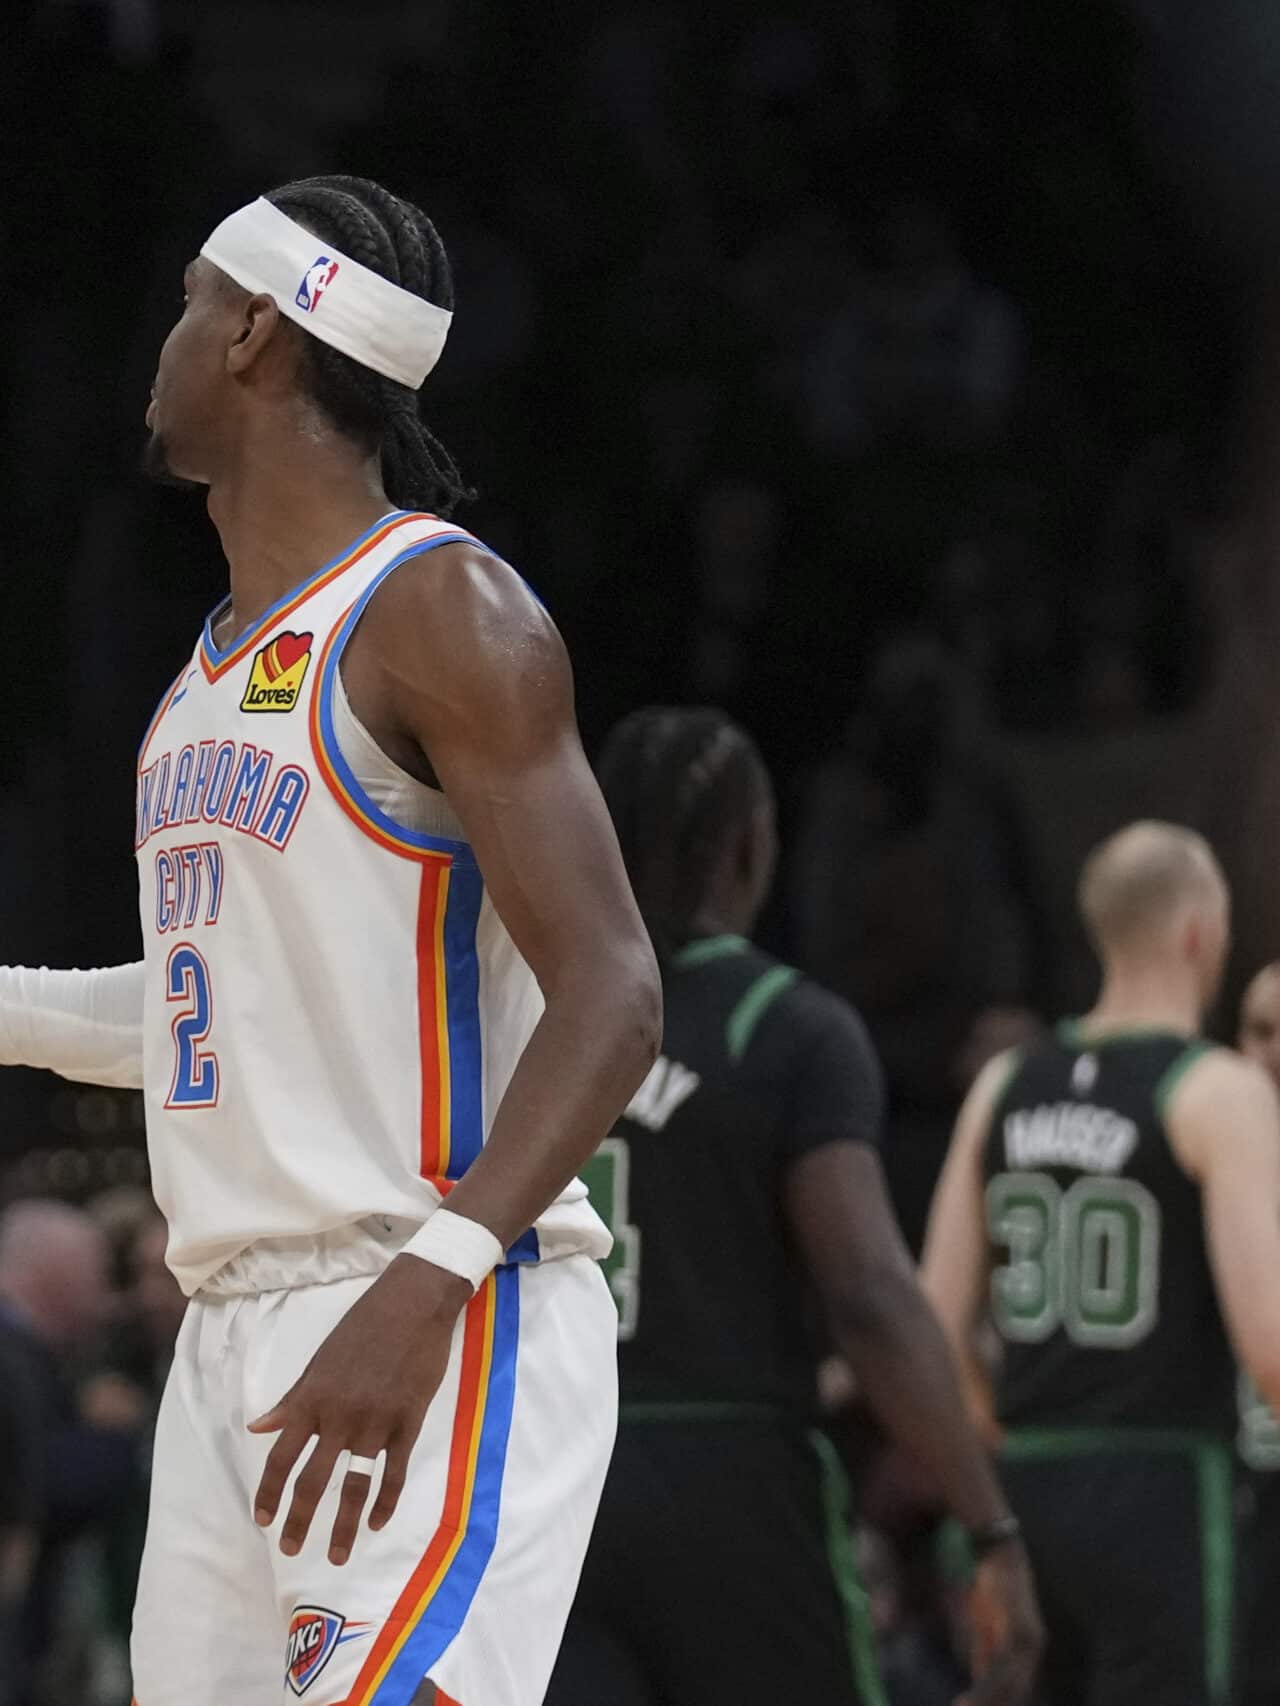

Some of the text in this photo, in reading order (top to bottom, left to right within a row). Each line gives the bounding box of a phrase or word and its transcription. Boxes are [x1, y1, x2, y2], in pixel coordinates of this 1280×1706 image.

[246, 681, 297, 705] Love's
[135, 739, 311, 854] KLAHOMA
[155, 842, 224, 935] CITY
[163, 941, 221, 1110] 2
[985, 1172, 1161, 1348] 30
